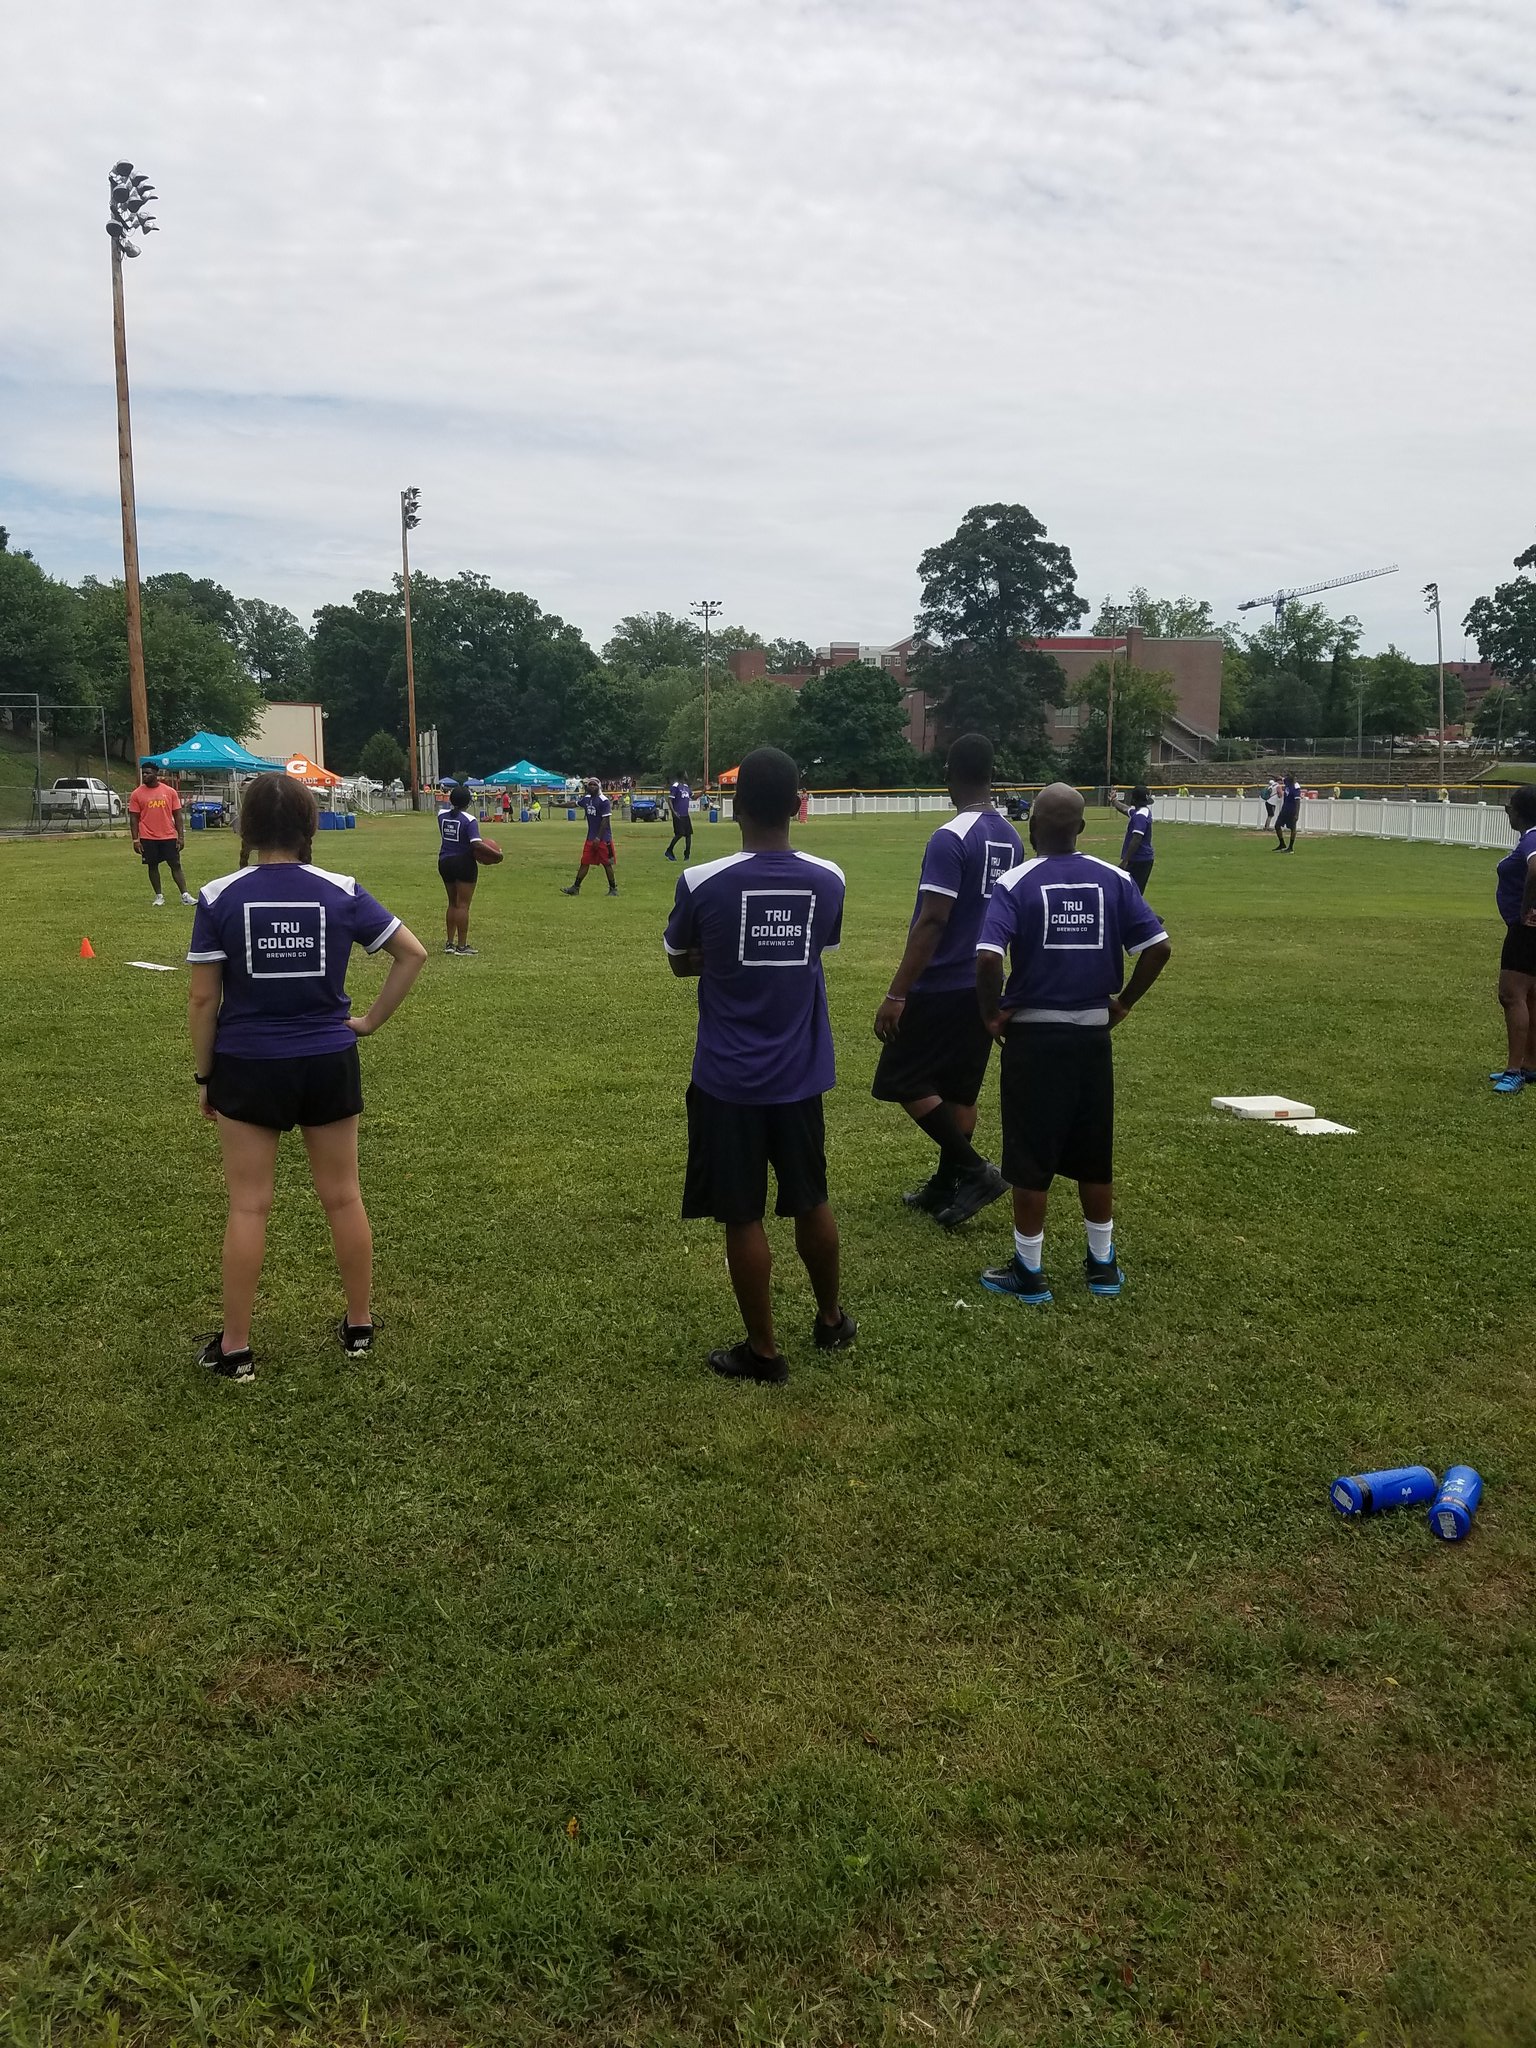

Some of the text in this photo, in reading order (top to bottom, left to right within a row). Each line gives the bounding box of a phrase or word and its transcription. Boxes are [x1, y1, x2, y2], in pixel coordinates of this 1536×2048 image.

[286, 760, 308, 774] G
[1063, 901, 1083, 911] TRU
[765, 910, 791, 922] TRU
[1051, 914, 1094, 924] COLORS
[271, 922, 300, 933] TRU
[751, 925, 801, 937] COLORS
[258, 937, 314, 949] COLORS
[353, 1338, 370, 1348] NIKE
[236, 1362, 252, 1374] NIKE
